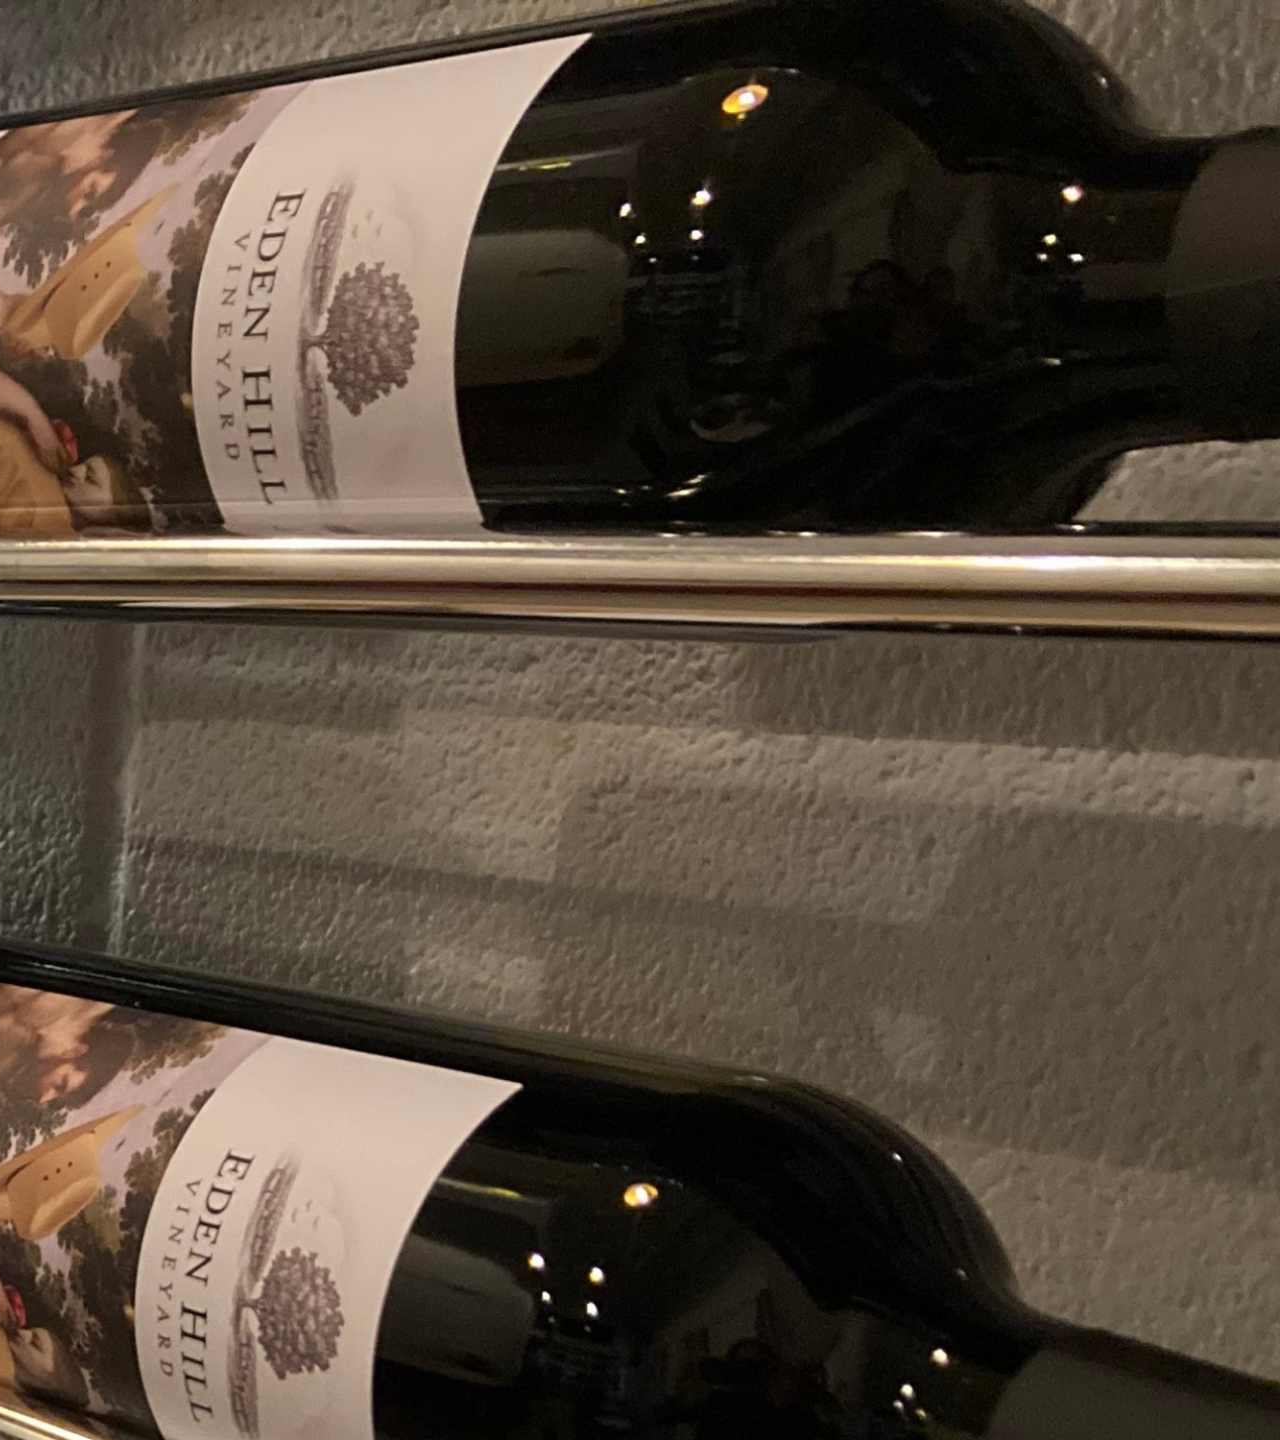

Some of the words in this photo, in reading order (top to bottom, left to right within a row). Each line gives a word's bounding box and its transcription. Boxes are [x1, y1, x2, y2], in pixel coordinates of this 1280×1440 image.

[243, 188, 307, 342] EDEN
[216, 232, 251, 462] VINEYARD
[242, 365, 288, 505] HILL
[154, 1176, 202, 1379] VINEYARD
[184, 1148, 255, 1287] EDEN
[179, 1301, 214, 1424] HILL
